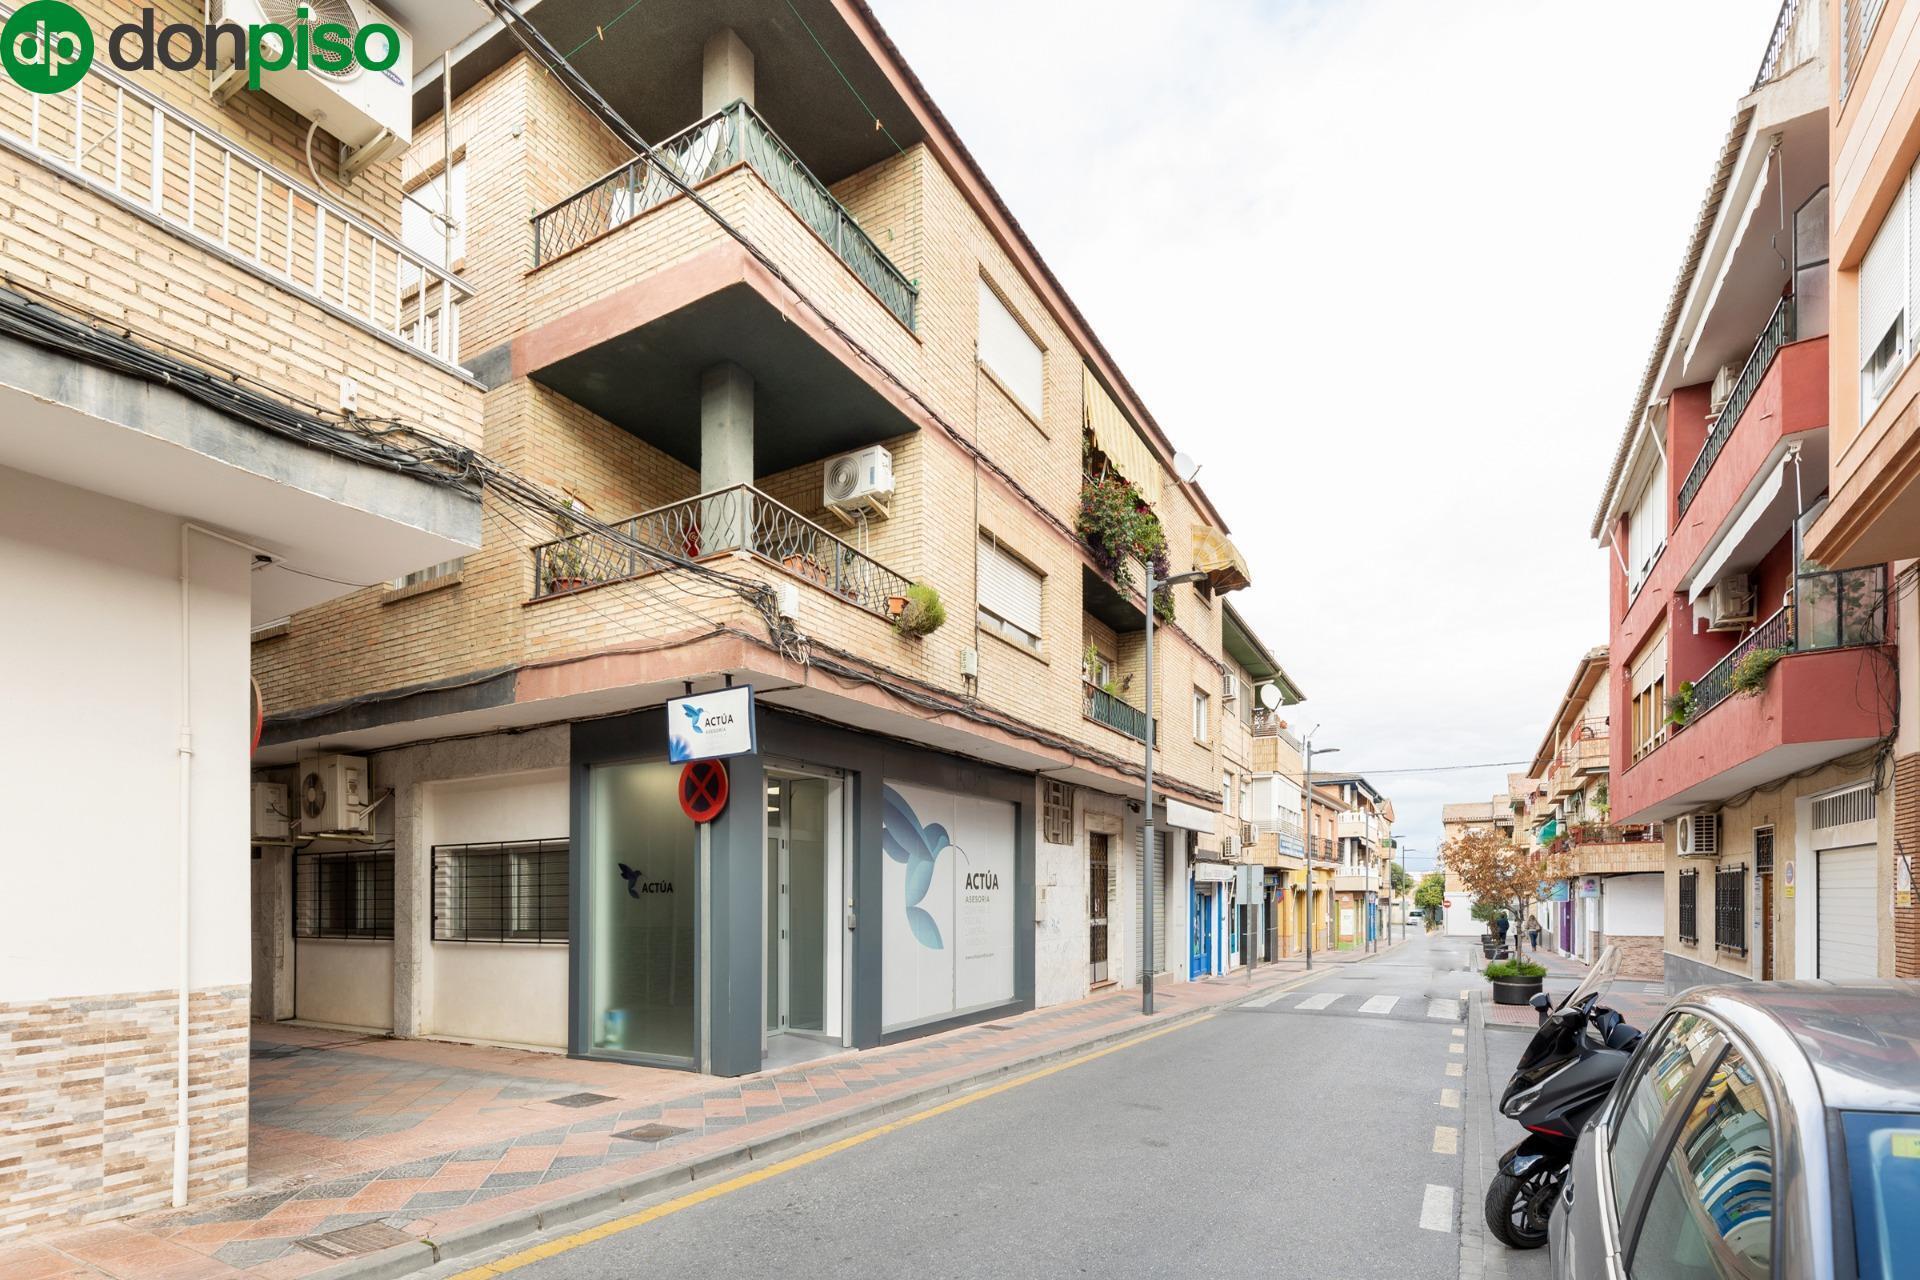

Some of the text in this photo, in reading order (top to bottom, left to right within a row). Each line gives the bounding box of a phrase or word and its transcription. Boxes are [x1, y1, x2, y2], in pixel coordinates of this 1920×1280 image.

[705, 713, 734, 728] ACTÚA
[641, 880, 674, 894] ACTÚA
[965, 869, 999, 890] ACTÚA
